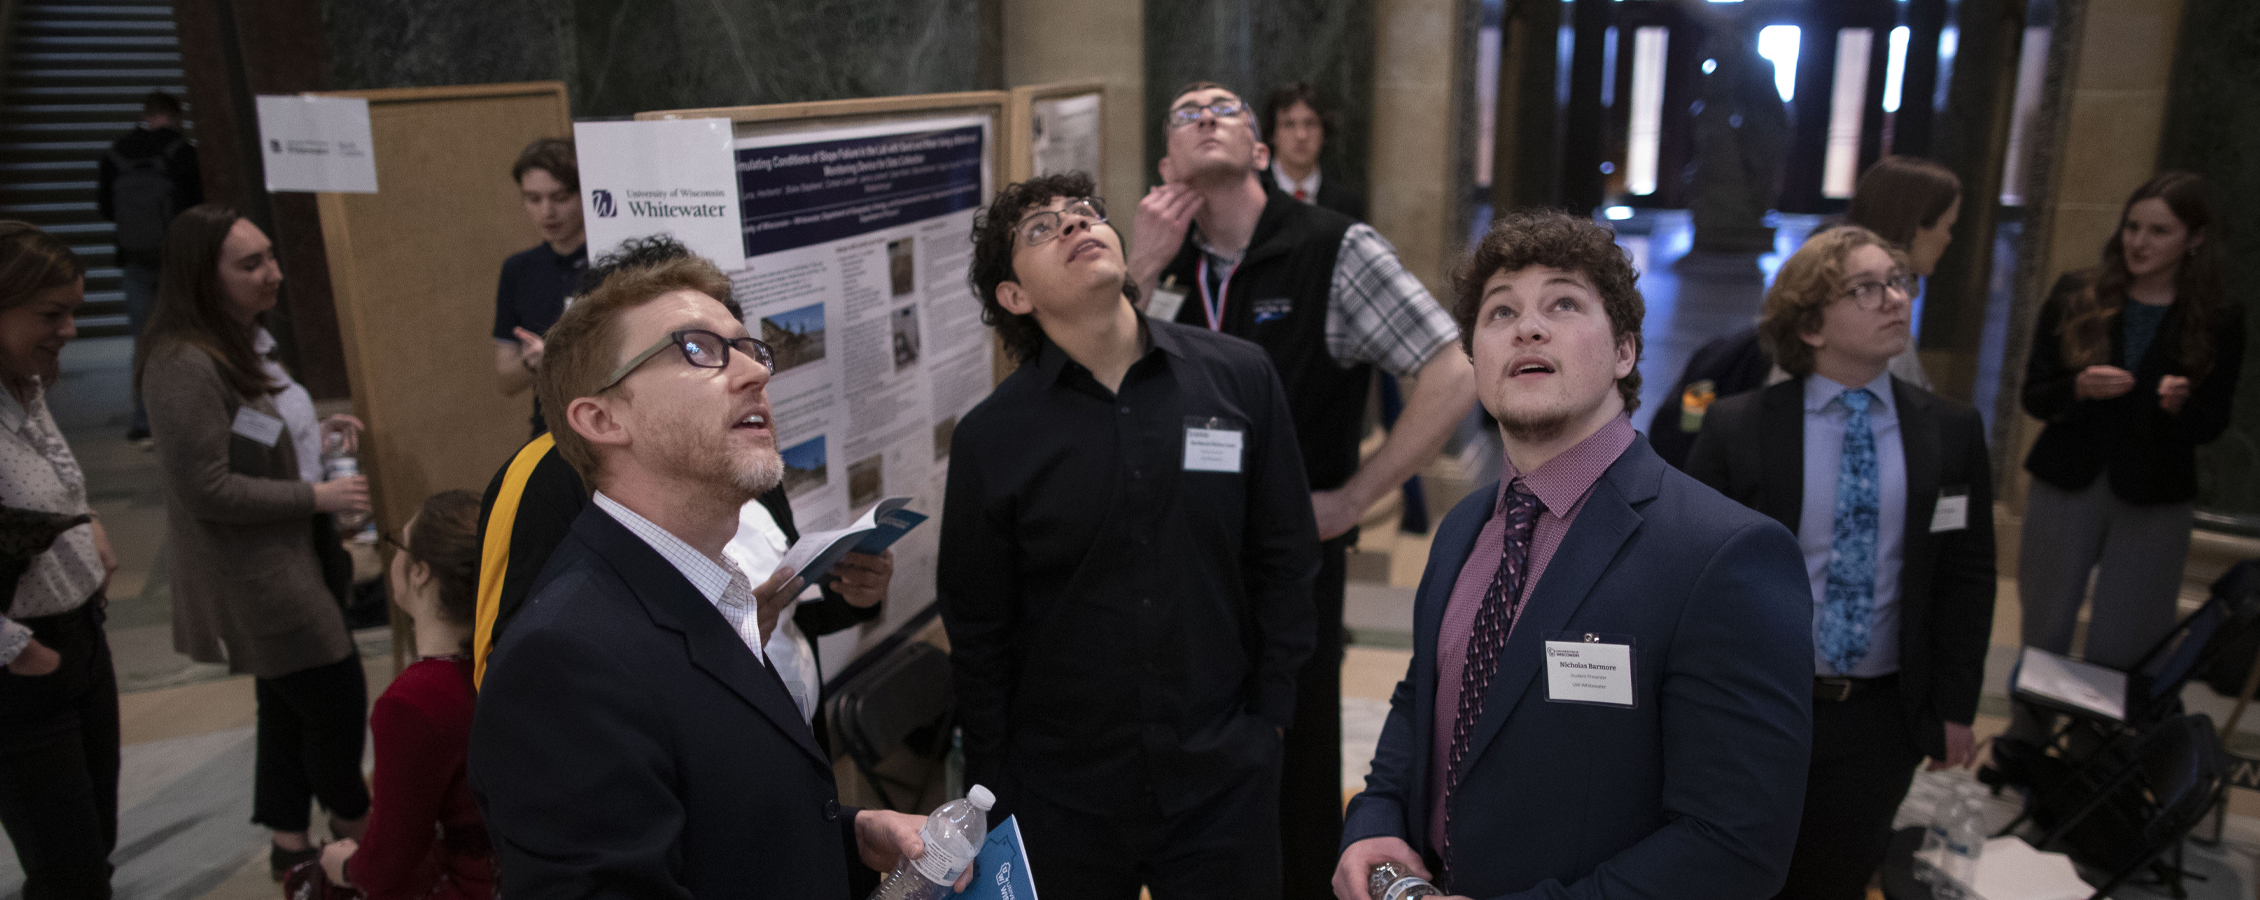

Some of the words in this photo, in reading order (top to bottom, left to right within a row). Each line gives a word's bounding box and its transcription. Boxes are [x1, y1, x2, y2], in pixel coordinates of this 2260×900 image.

[736, 158, 772, 172] mulating
[627, 189, 667, 200] University
[670, 188, 678, 198] of
[680, 188, 725, 197] Wisconsin
[628, 200, 726, 217] Whitewater
[1560, 661, 1588, 669] Nicholas
[1589, 663, 1617, 671] Barmore
